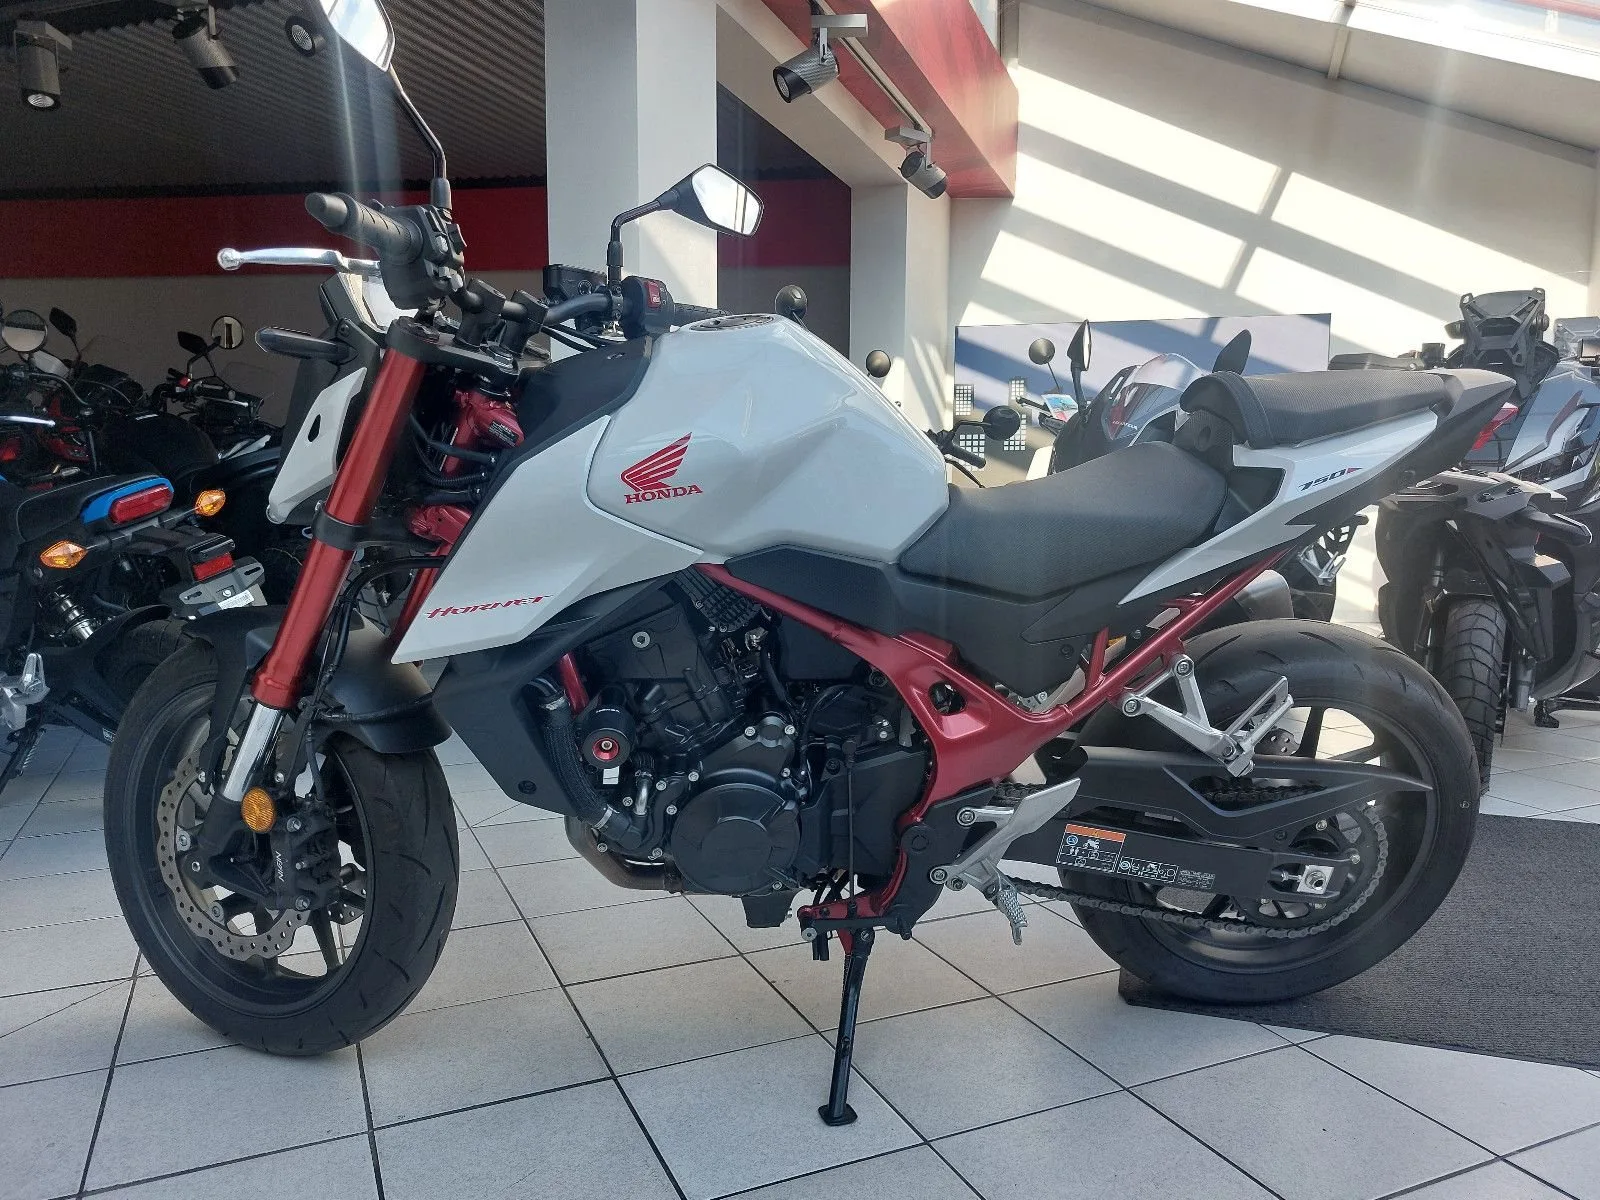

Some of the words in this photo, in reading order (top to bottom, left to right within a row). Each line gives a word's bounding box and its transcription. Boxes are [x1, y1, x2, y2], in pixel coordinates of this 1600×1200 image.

[1298, 468, 1346, 491] 750
[624, 484, 703, 504] HONDA
[425, 594, 554, 618] HORNET
